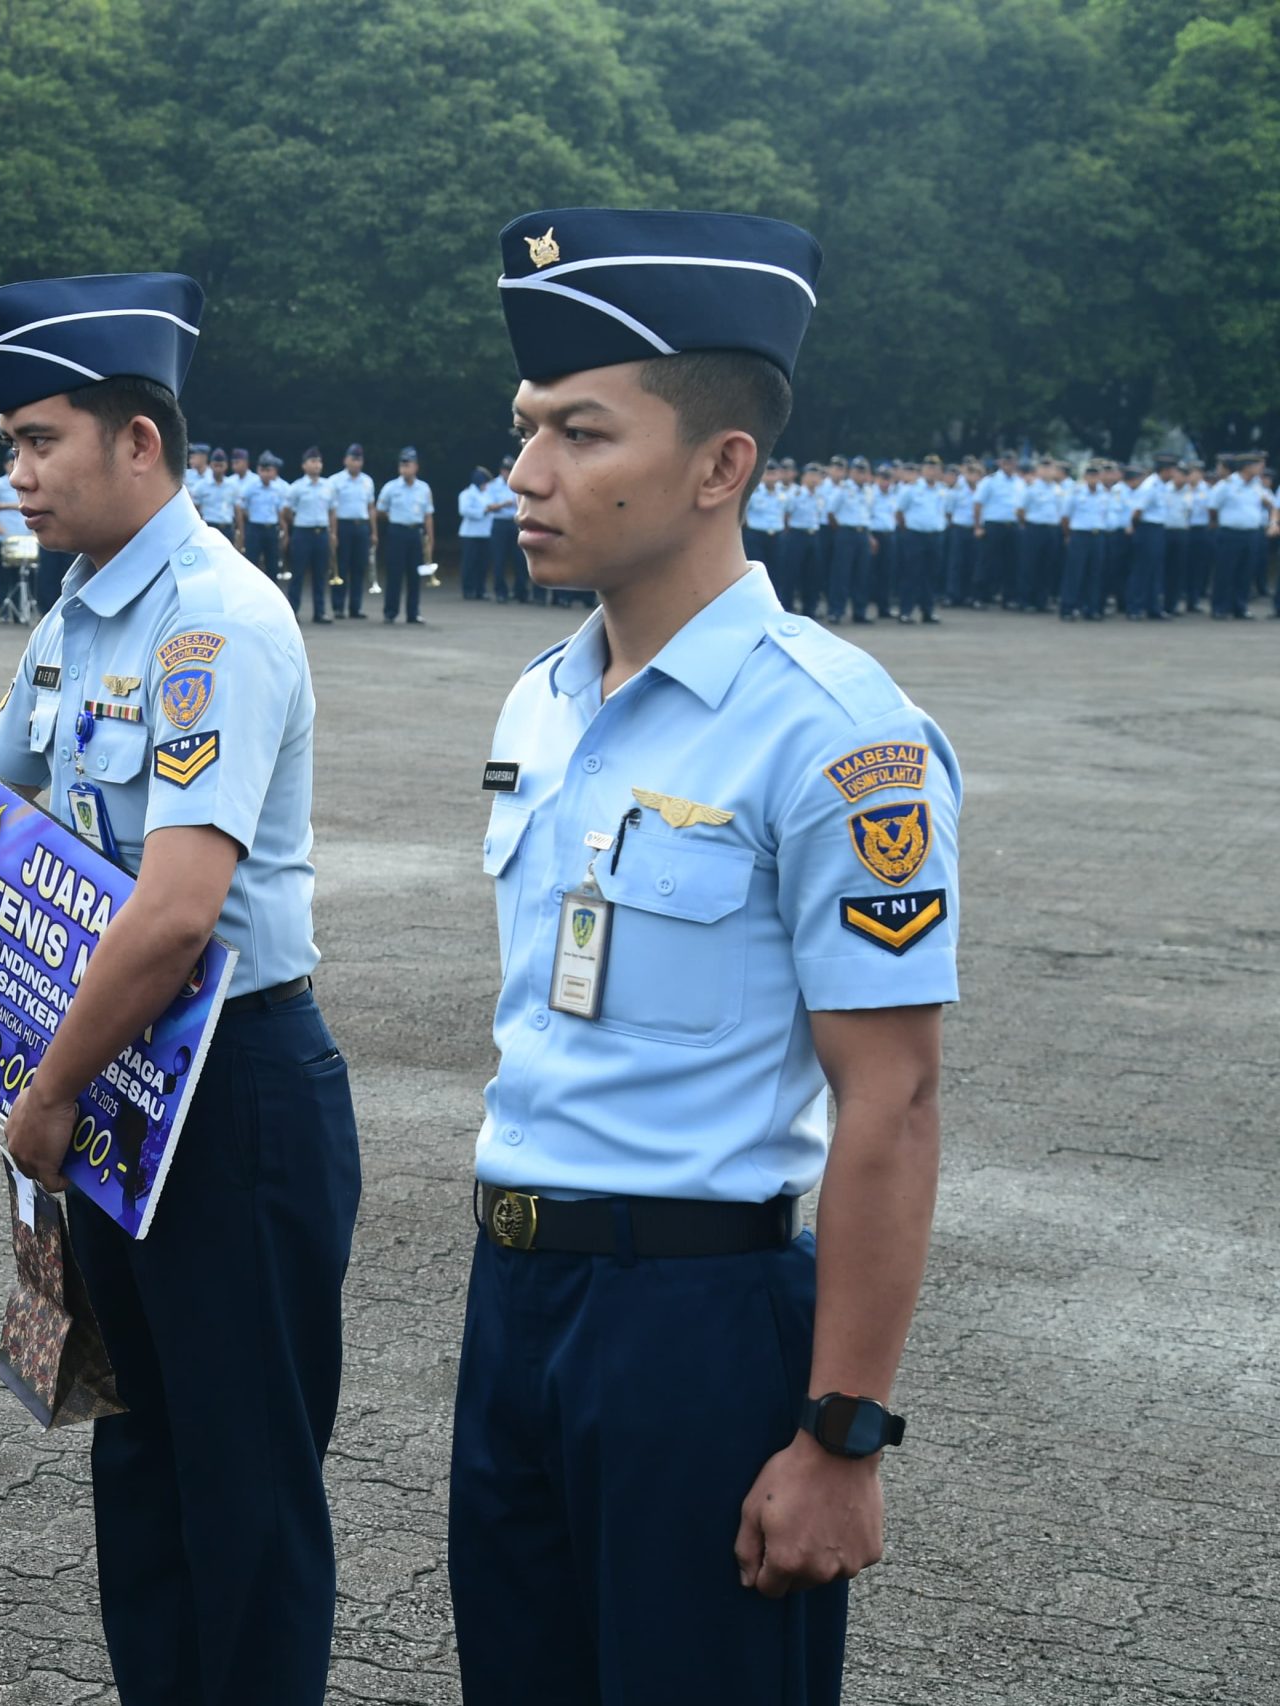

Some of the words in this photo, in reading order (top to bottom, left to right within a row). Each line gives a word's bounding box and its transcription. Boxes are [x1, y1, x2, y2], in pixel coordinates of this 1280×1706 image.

[163, 635, 217, 658] MABESAU
[169, 736, 200, 752] TNI
[836, 747, 919, 778] MABESAU
[847, 767, 919, 796] DISINFOLAHTA
[21, 844, 112, 941] JUARA
[871, 898, 917, 915] TNI
[23, 1025, 41, 1050] HUT
[97, 1091, 120, 1118] 2025
